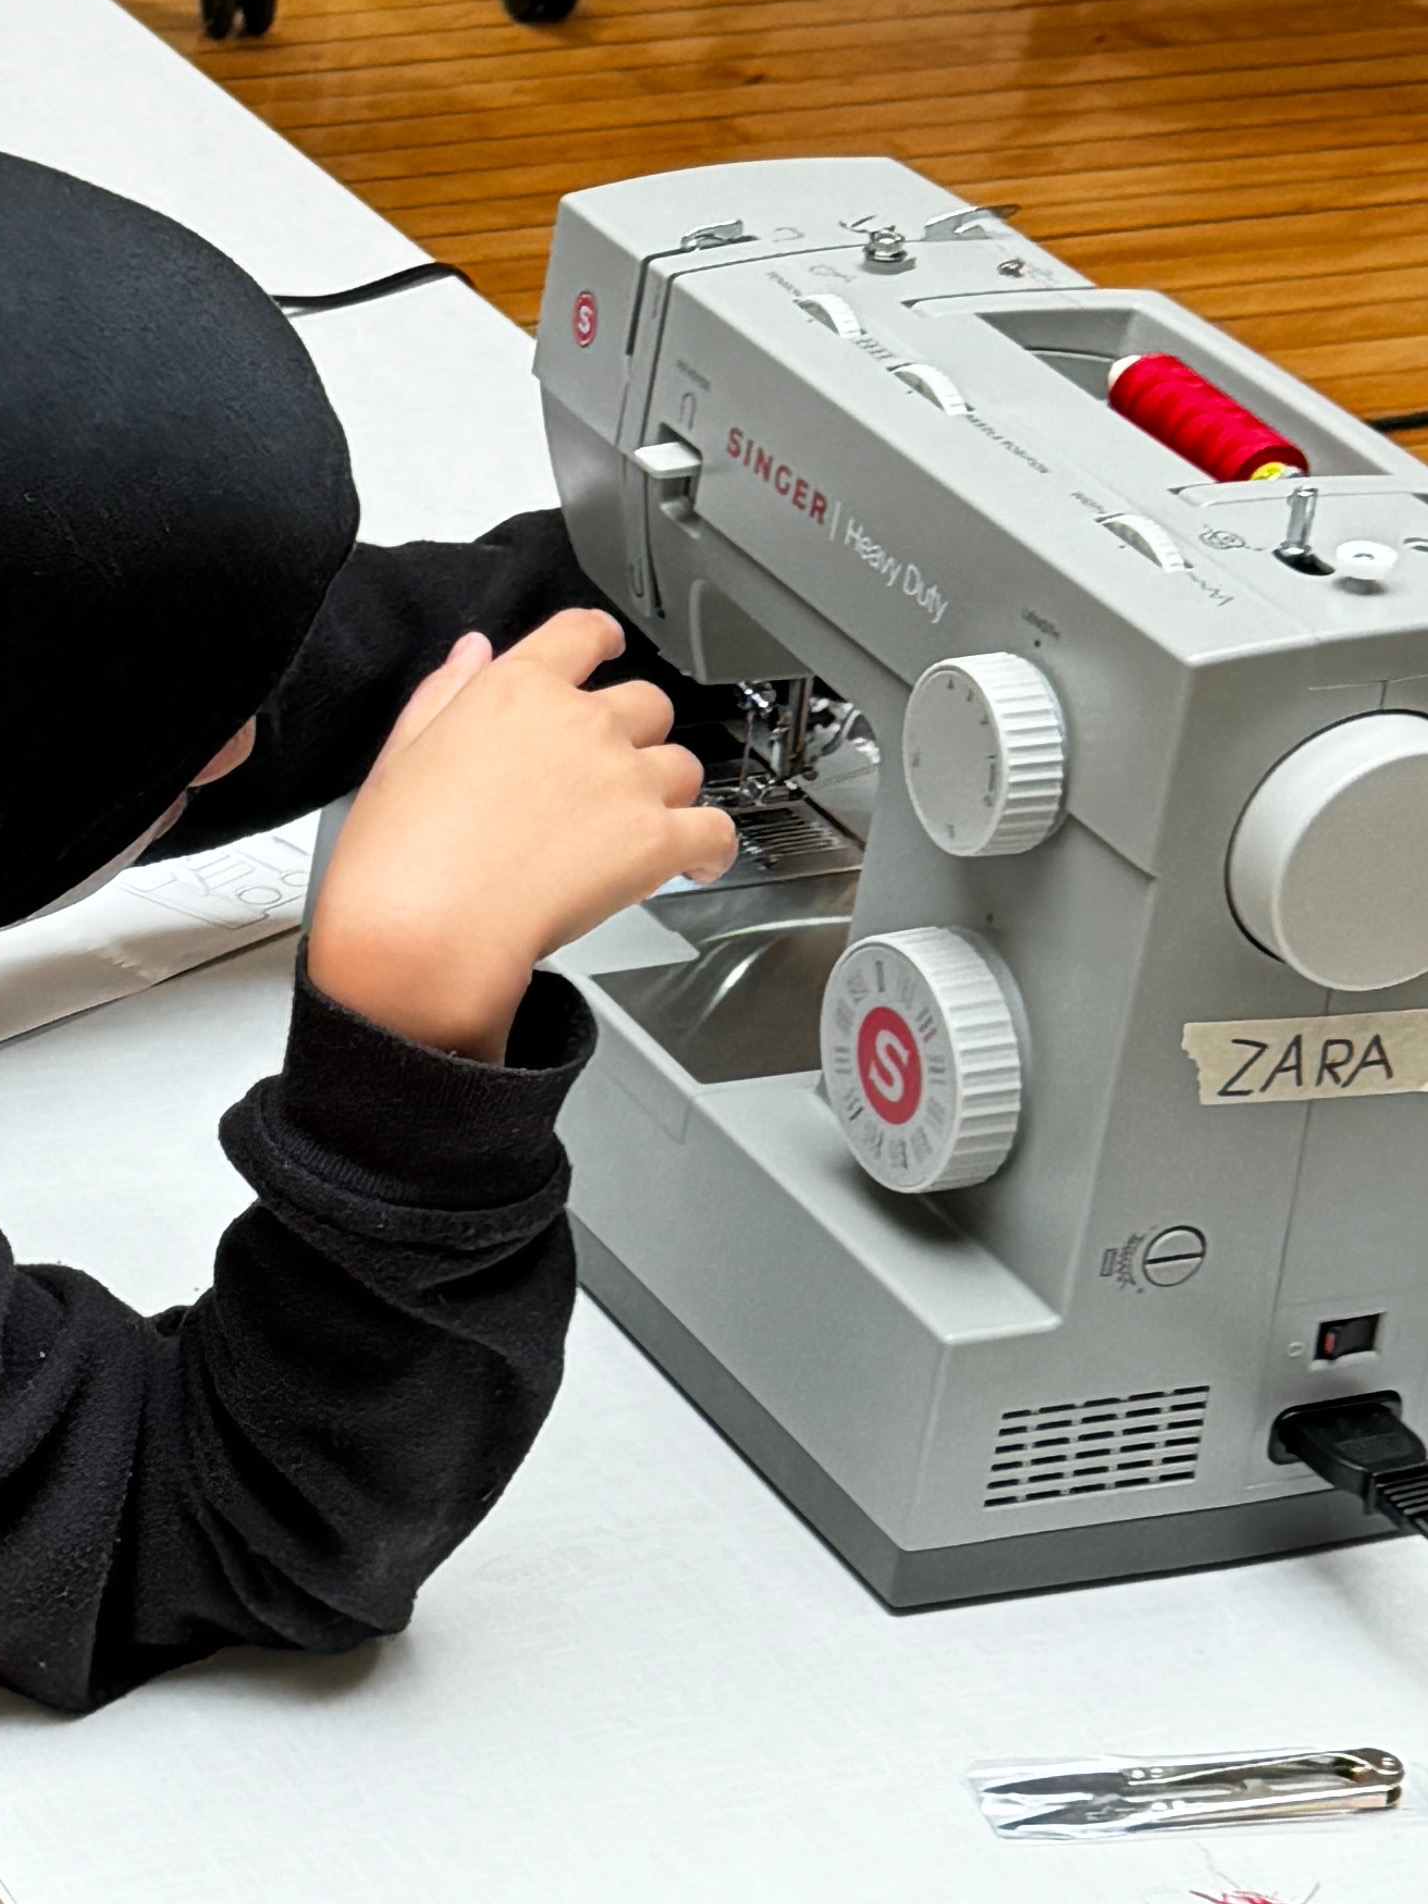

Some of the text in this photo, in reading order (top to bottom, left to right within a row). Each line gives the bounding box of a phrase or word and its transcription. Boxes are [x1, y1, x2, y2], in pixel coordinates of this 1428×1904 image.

[725, 426, 829, 526] SINGER
[844, 516, 903, 588] Heavy
[902, 563, 949, 624] Duty
[869, 1029, 911, 1103] S
[1217, 1032, 1394, 1097] ZARA
